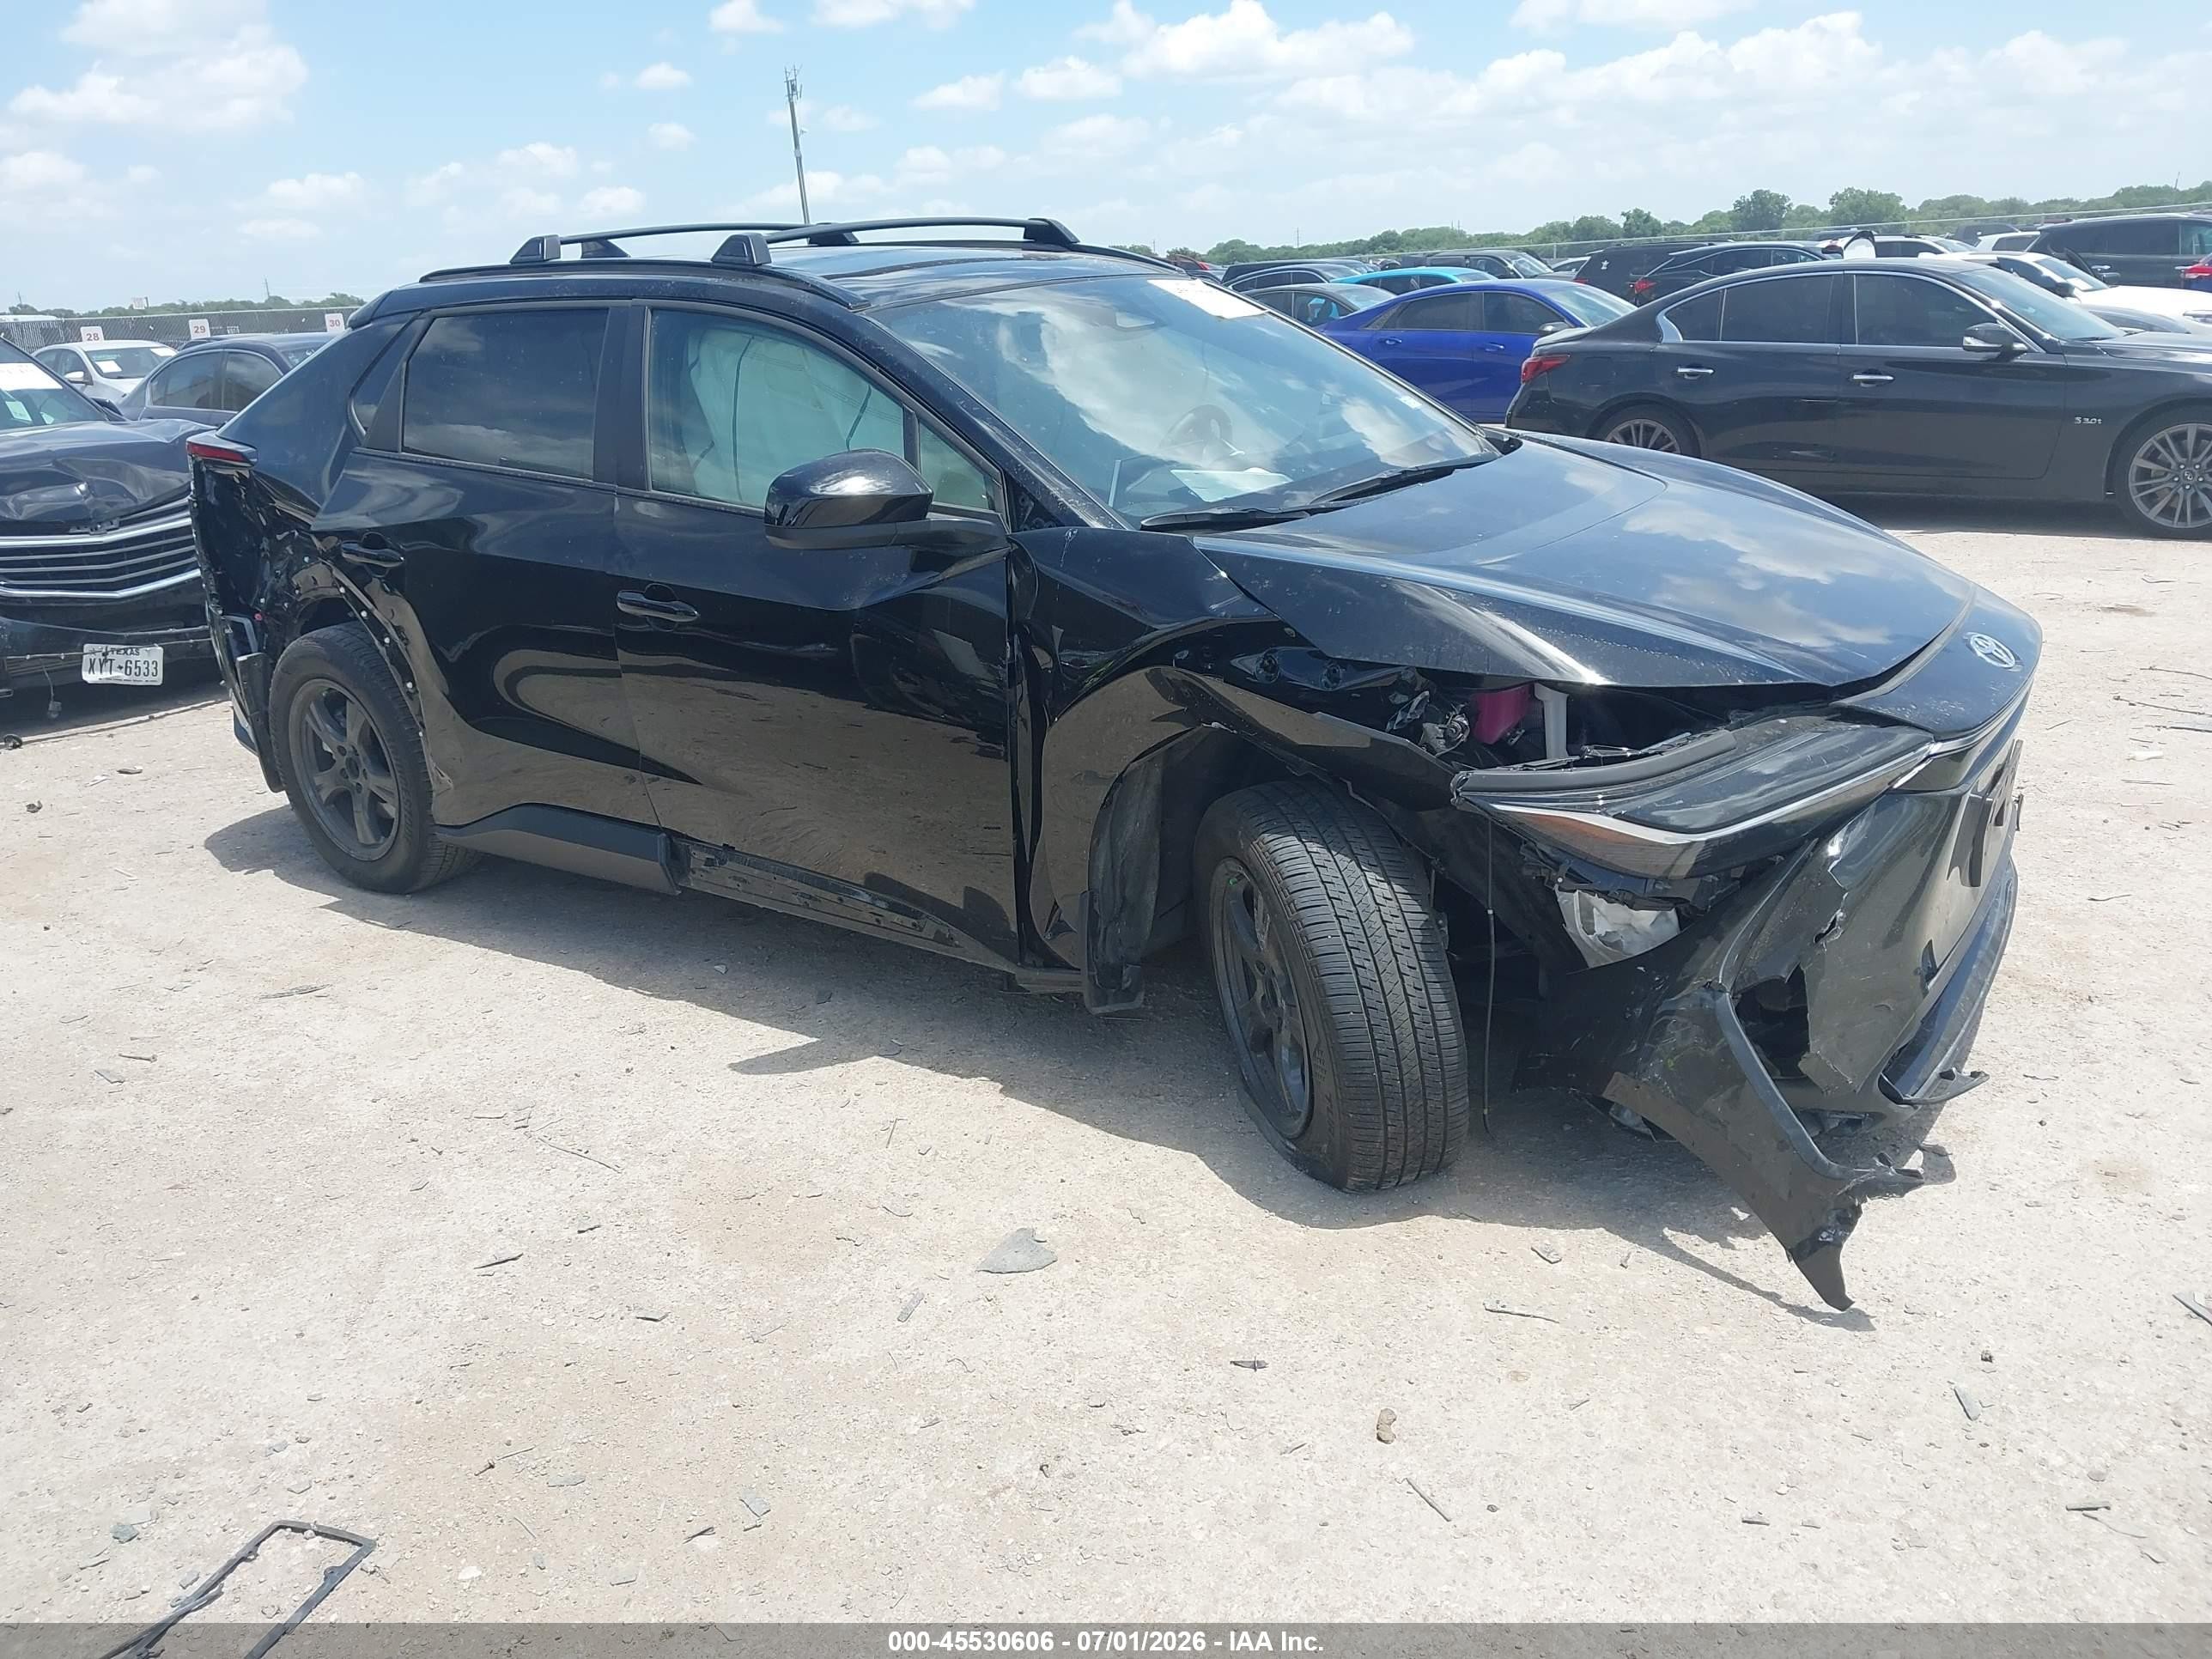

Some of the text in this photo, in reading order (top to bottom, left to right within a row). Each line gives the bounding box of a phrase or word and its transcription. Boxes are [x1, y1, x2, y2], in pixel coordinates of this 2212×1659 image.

[193, 325, 206, 334] 29
[86, 332, 100, 342] 28
[111, 647, 140, 655] TEXAS
